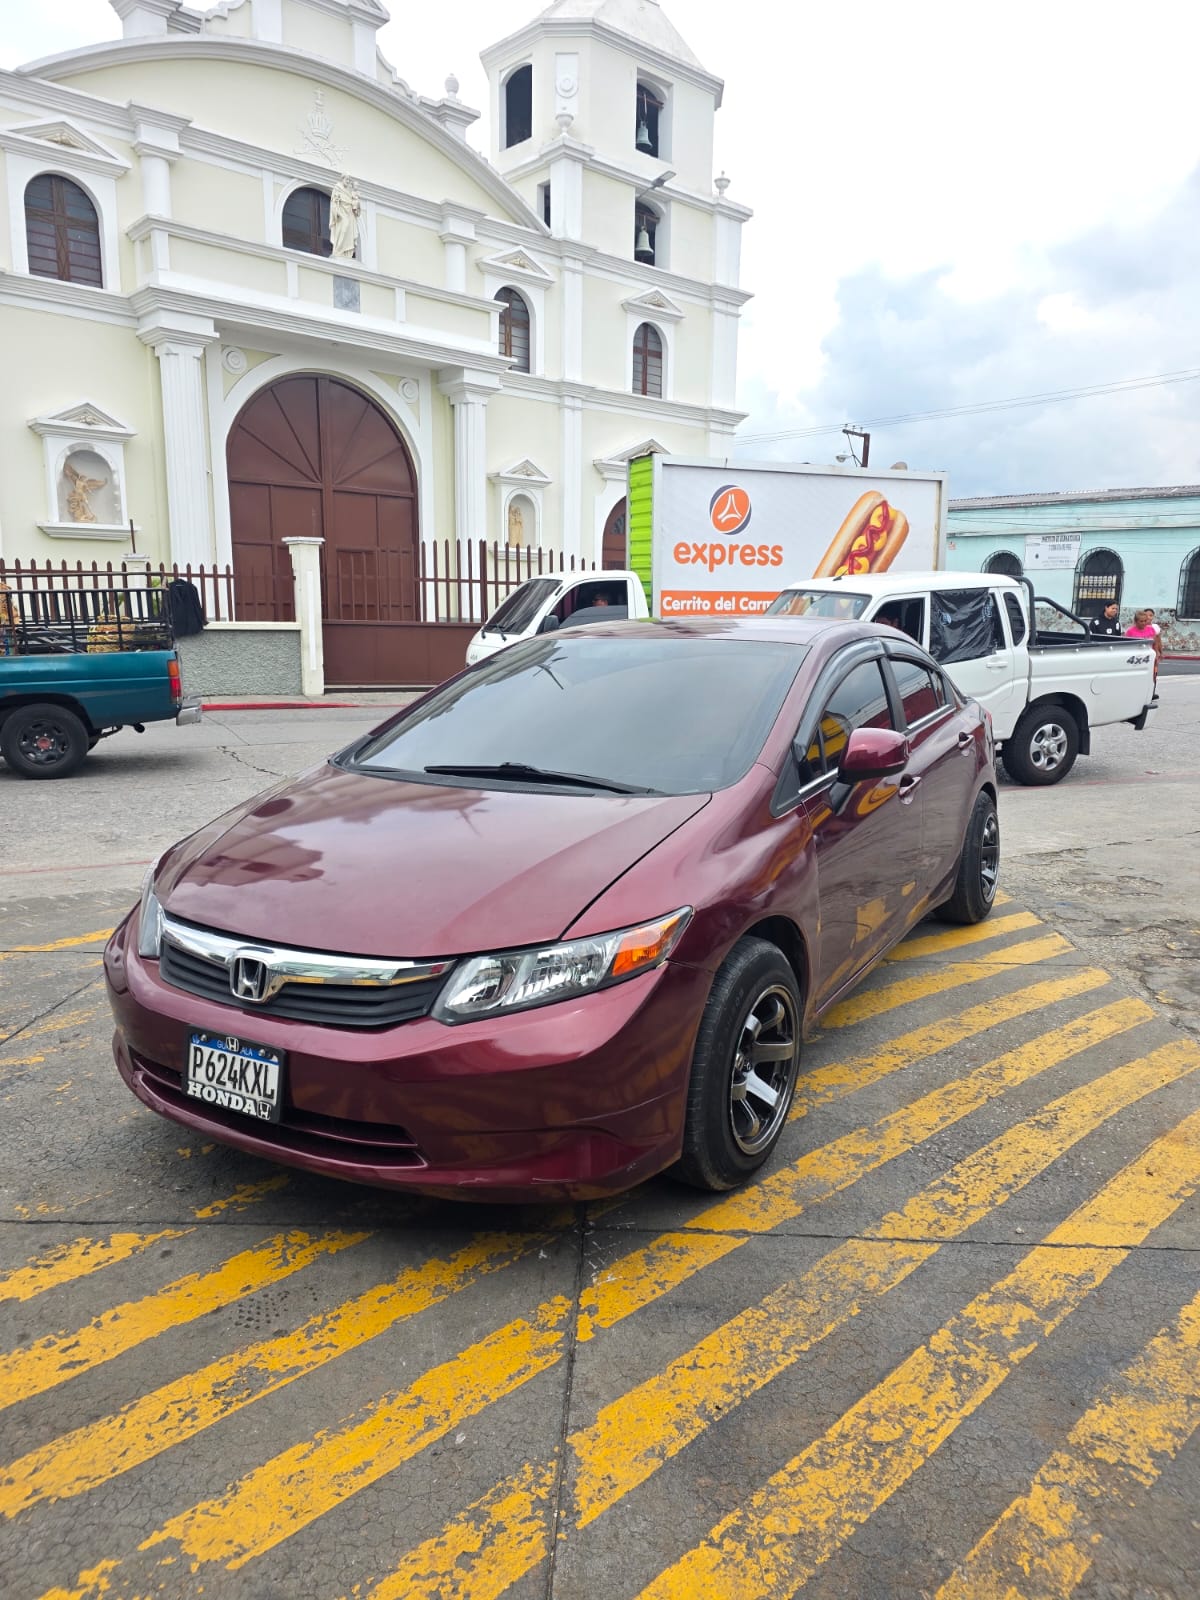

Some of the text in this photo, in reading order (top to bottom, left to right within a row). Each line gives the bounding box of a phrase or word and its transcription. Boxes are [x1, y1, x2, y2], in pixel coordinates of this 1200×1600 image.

[673, 541, 783, 573] express
[662, 596, 711, 611] Cerrito
[714, 596, 736, 611] del
[193, 1045, 275, 1100] P624KXL
[187, 1081, 257, 1116] HONDA
